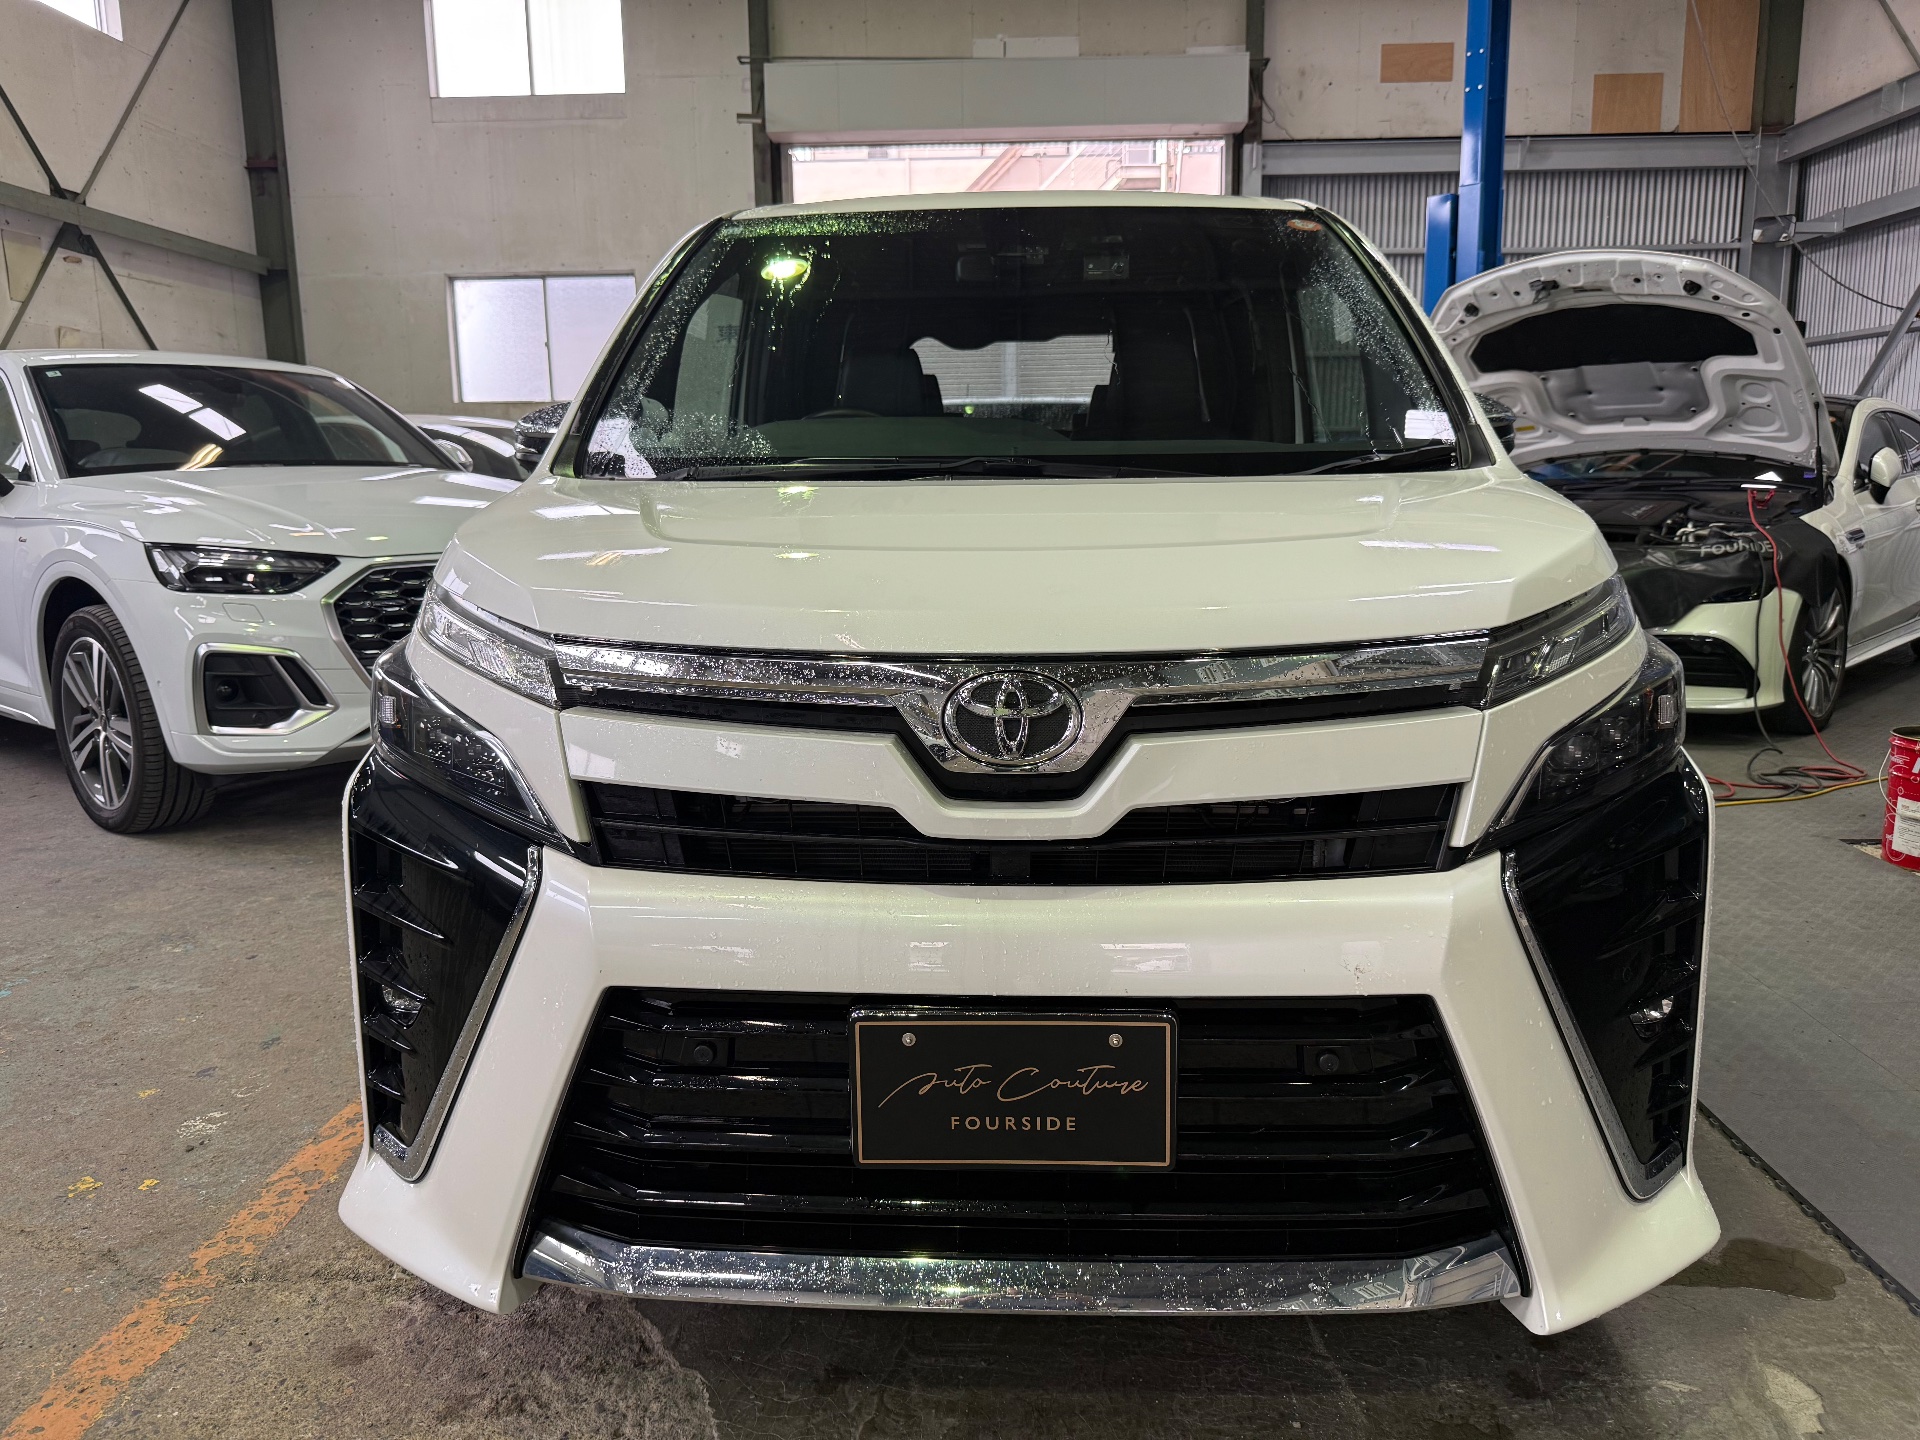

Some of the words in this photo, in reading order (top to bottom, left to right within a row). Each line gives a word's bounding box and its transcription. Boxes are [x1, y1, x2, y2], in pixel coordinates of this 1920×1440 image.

[878, 1064, 992, 1108] Auto
[996, 1064, 1149, 1102] Couture
[951, 1116, 1077, 1131] FOURSIDE
